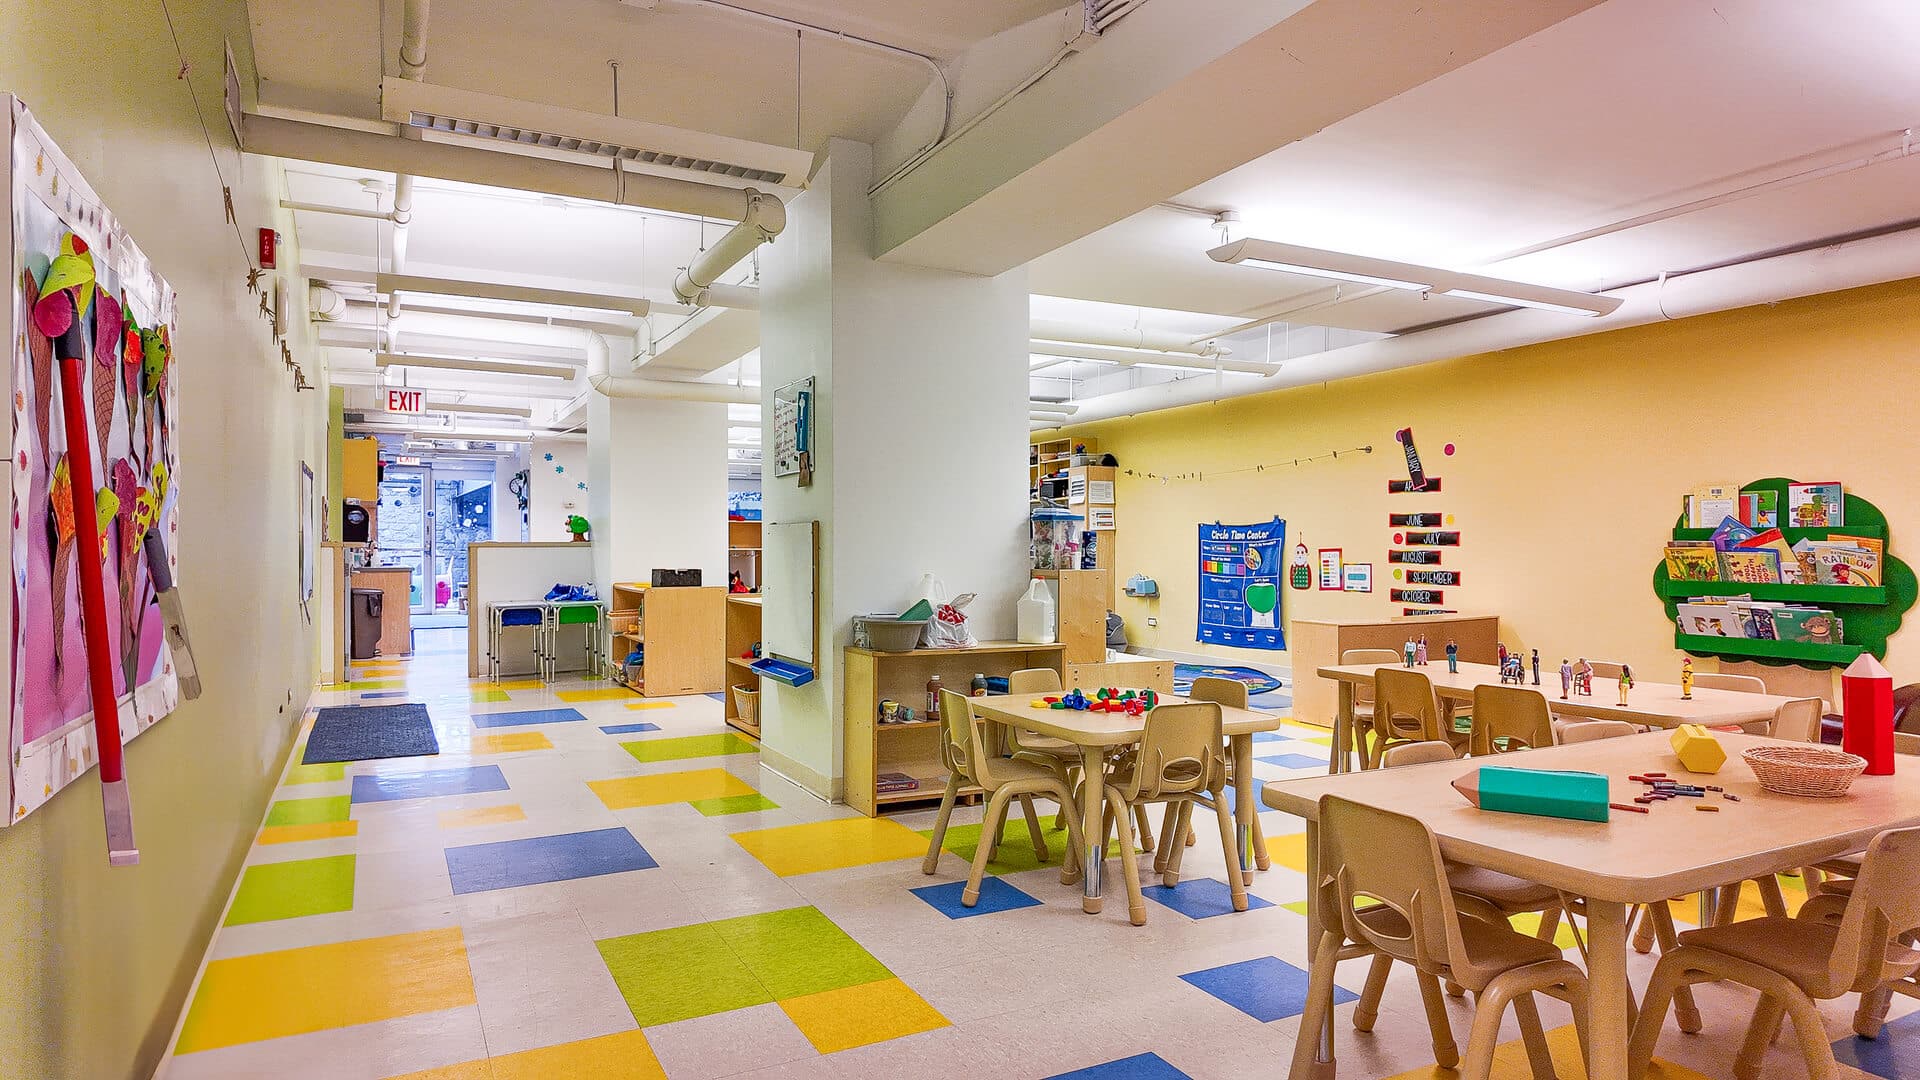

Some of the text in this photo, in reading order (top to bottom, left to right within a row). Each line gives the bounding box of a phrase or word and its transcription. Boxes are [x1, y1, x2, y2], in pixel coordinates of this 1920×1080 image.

[389, 390, 422, 411] EXIT
[1406, 514, 1424, 526] JUNE
[1211, 529, 1269, 540] Circle Time Center
[1423, 532, 1441, 545] JULY
[1402, 551, 1426, 563] AUGUST
[1822, 555, 1873, 570] RAINBOW
[1413, 571, 1453, 584] SEPTEMBER
[1402, 590, 1431, 602] OCTOBER
